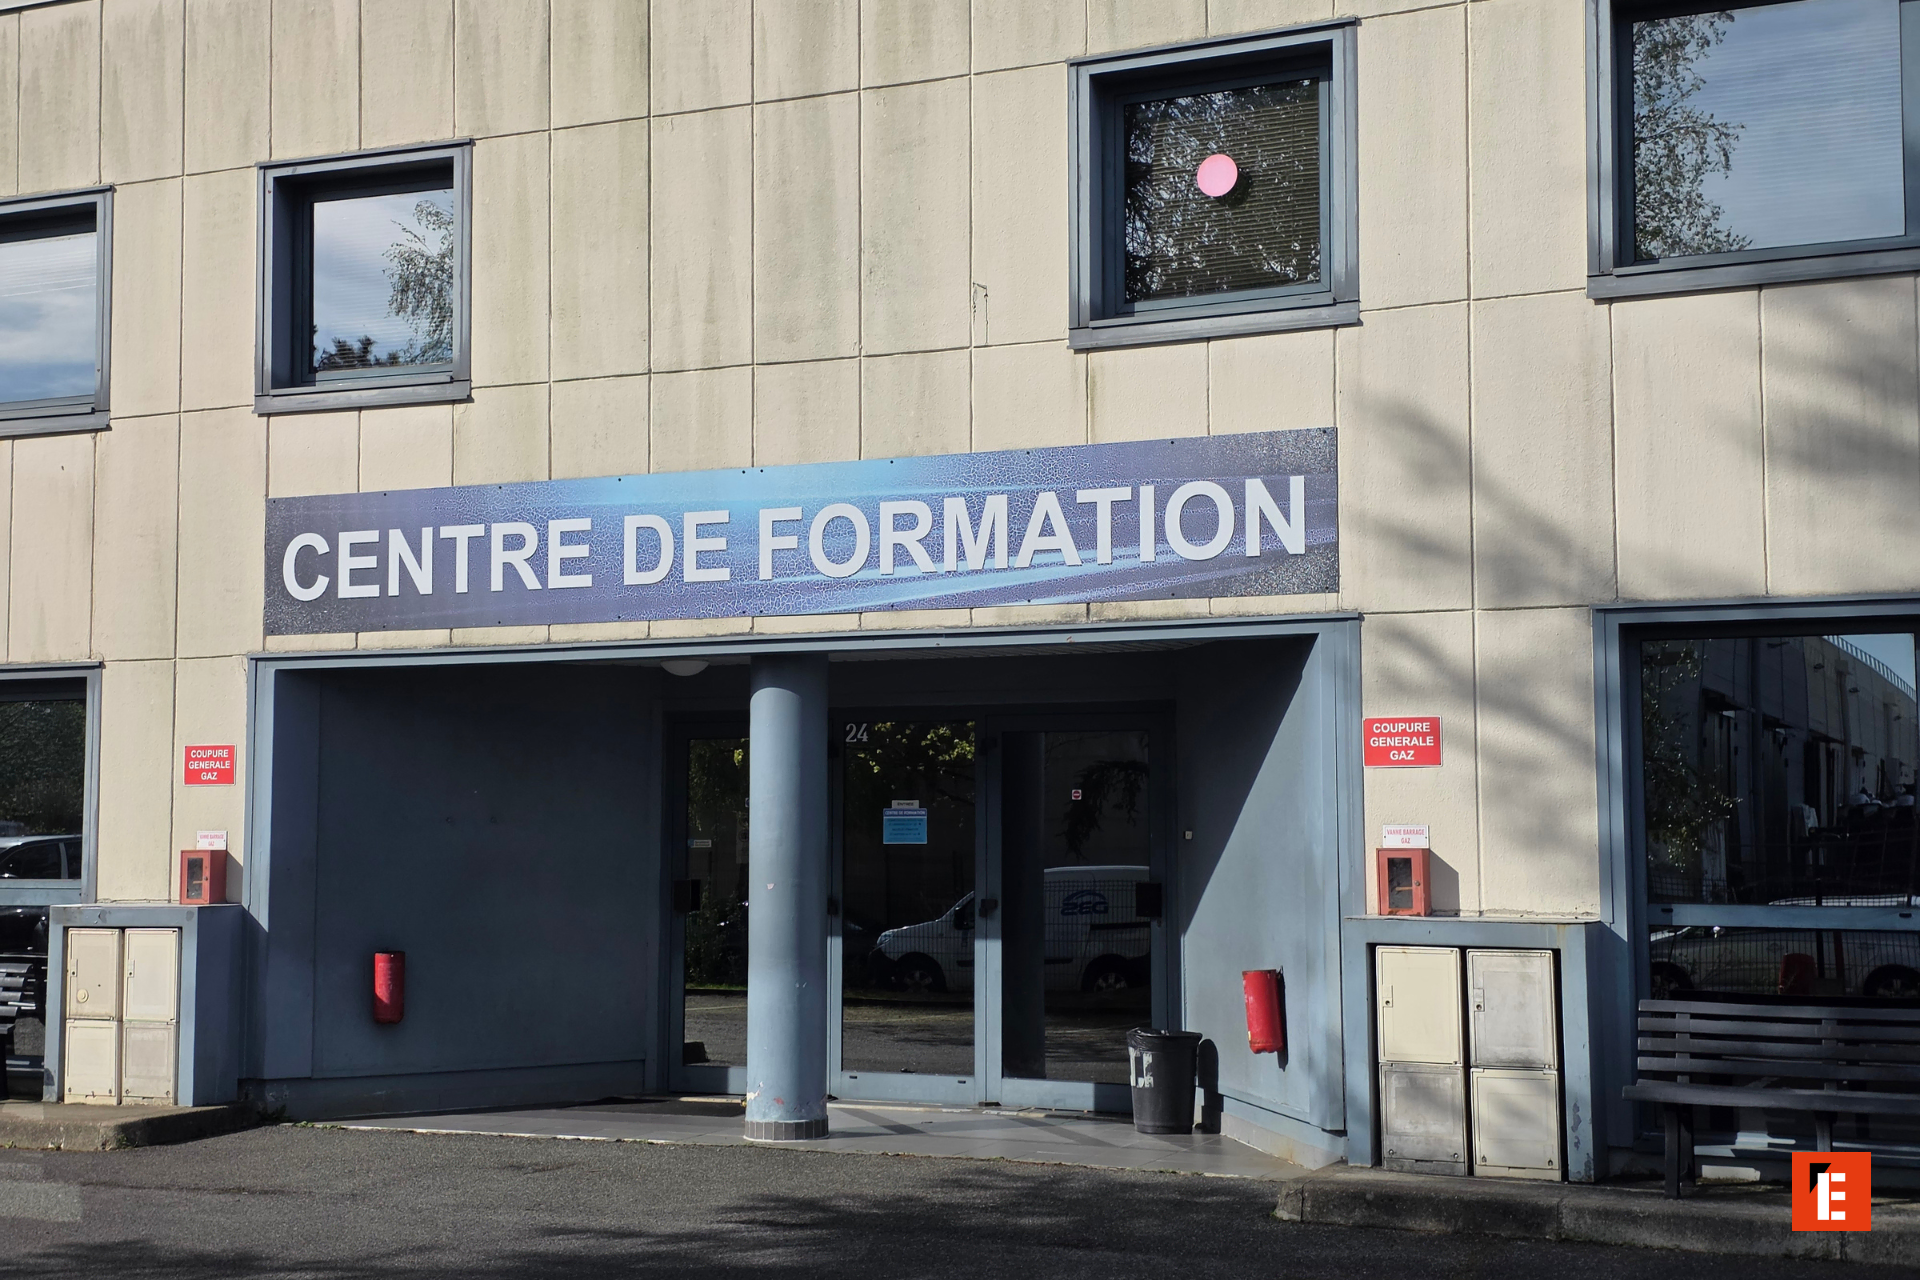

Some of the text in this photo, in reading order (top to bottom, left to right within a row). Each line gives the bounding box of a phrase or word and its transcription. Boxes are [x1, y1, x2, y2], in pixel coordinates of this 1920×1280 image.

[282, 475, 1306, 601] CENTRE DE FORMATION
[845, 723, 868, 742] 24
[1373, 722, 1431, 733] COUPURE
[1370, 736, 1434, 747] GENERALE
[190, 749, 229, 758] COUPURE
[1390, 750, 1415, 760] GAZ
[188, 760, 231, 769] GENERALE
[201, 772, 217, 780] GAZ
[1386, 828, 1425, 836] VANNE BARRAGE
